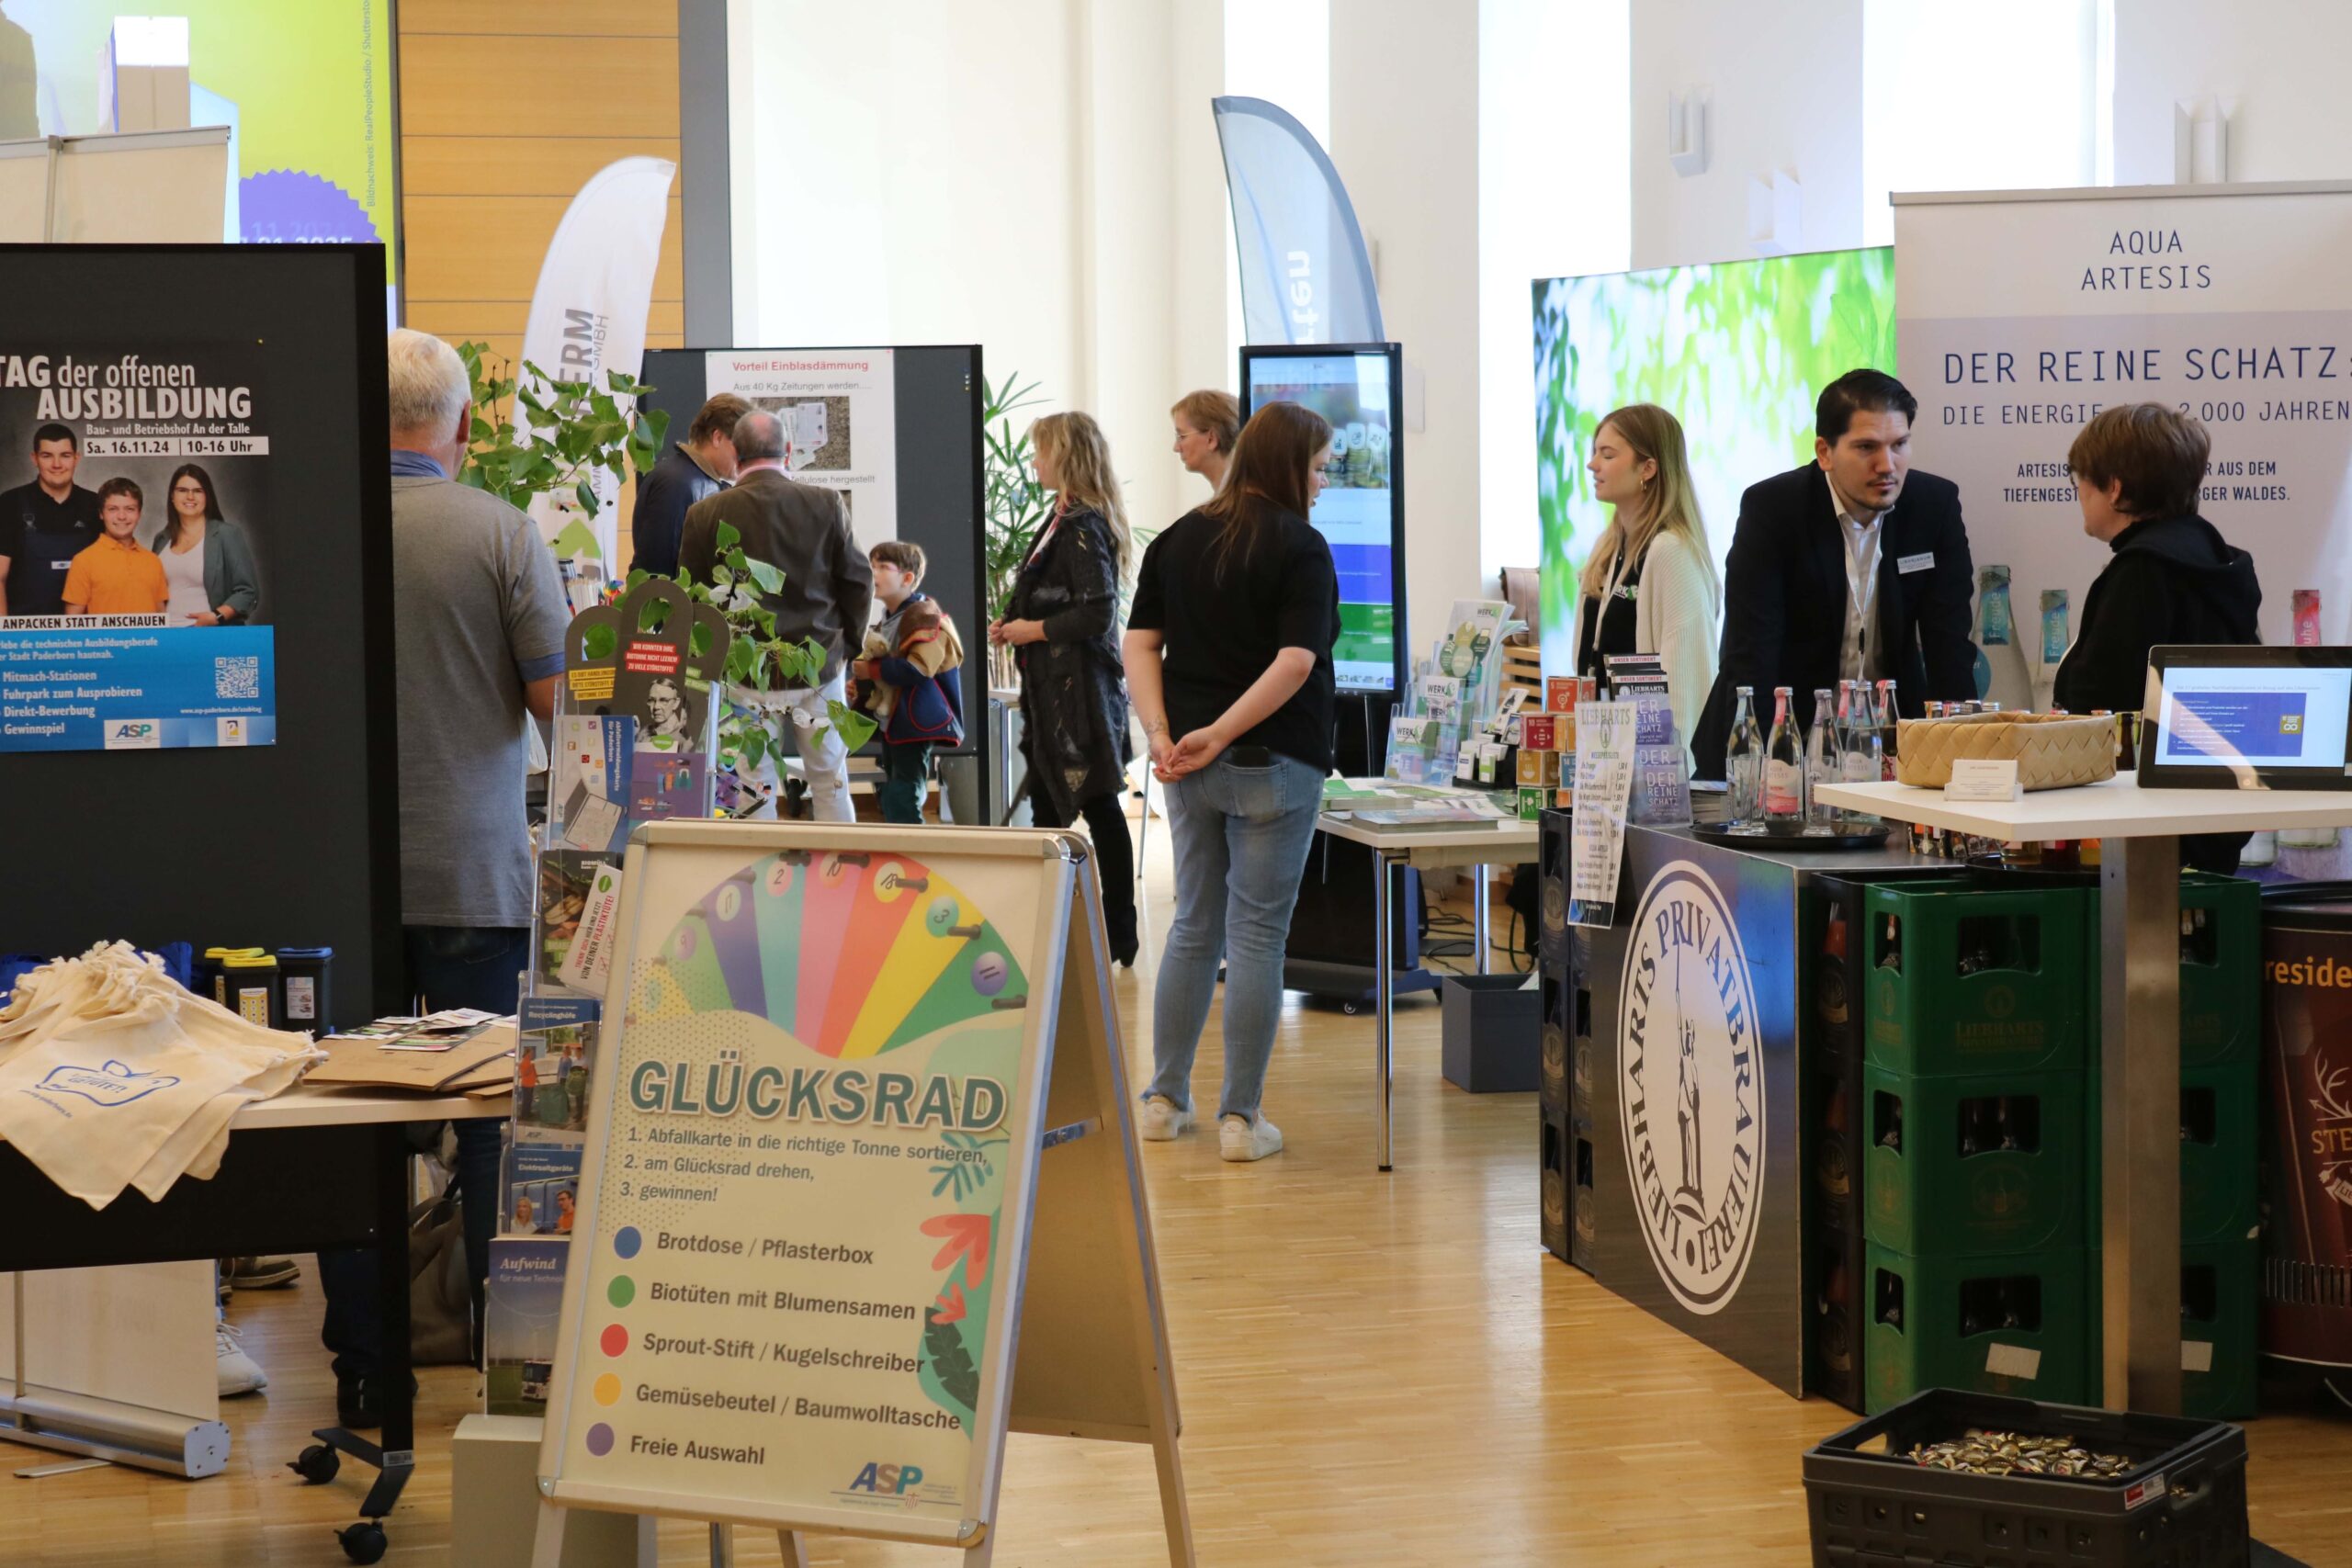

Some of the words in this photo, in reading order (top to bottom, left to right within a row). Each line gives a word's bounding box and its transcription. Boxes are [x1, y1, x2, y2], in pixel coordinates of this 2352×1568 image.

[2109, 230, 2183, 255] AQUA
[2081, 265, 2211, 291] ARTESIS
[58, 355, 98, 387] der
[106, 355, 196, 387] offenen
[732, 362, 768, 371] Vorteil
[772, 361, 868, 373] Einblasdämmung
[1945, 352, 2017, 384] DER
[2039, 350, 2162, 382] REINE
[733, 383, 751, 391] Aus
[766, 383, 778, 392] Kg
[781, 382, 825, 392] Zeitungen
[37, 387, 252, 420] AUSBILDUNG
[1943, 405, 1985, 425] DIE
[2002, 403, 2103, 424] ENERGIE
[2259, 400, 2349, 421] JAHREN
[85, 423, 109, 435] Bau-
[113, 423, 131, 434] und
[134, 423, 191, 435] Betriebshof
[193, 423, 207, 434] An
[209, 423, 224, 434] der
[228, 423, 250, 434] Talle
[86, 441, 106, 455] Sa.
[111, 441, 169, 453] 16.11.24
[187, 441, 225, 452] 10-16
[230, 441, 254, 452] Uhr
[2217, 462, 2244, 476] AUS
[2248, 461, 2277, 476] DEM
[830, 475, 875, 485] hergestellt
[2233, 486, 2290, 501] WALDES.
[3, 618, 62, 629] ANPACKEN
[65, 617, 97, 628] STATT
[102, 615, 166, 627] ANSCHAUEN
[1989, 592, 2001, 638] Freude
[2050, 612, 2061, 657] Freude
[8, 653, 30, 661] Stadt
[32, 651, 75, 660] Paderborn
[3, 671, 96, 682] Mitmach-Stationen
[4, 689, 50, 701] Fuhrpark
[52, 690, 74, 699] zum
[76, 687, 142, 700] Ausprobieren
[4, 705, 96, 719] Direkt-Bewerbung
[1639, 699, 1660, 715] ER
[5, 723, 65, 737] Gewinnspiel
[116, 724, 153, 739] ASP
[1646, 772, 1678, 787] DER
[1647, 787, 1678, 796] REINE
[1648, 797, 1678, 807] SCHATZ
[827, 861, 842, 876] 10
[774, 869, 785, 885] 2
[595, 896, 615, 942] PLASTIKTÜTE!
[933, 909, 950, 924] 3
[585, 941, 599, 965] DEINER
[581, 965, 591, 980] VON
[528, 1011, 576, 1021] Recyclinghöfe
[629, 1050, 1007, 1131] GLÜCKSRAD
[1655, 900, 1753, 1275] PRIVATBRAUEREI
[1628, 942, 1684, 1261] LIEBHARTS
[628, 1128, 642, 1143] 1.
[648, 1129, 732, 1148] Abfallkarte
[738, 1133, 752, 1148] in
[758, 1134, 781, 1150] die
[786, 1135, 845, 1156] richtige
[852, 1139, 900, 1157] Tonne
[907, 1144, 988, 1167] sortieren,
[624, 1155, 639, 1169] 2.
[644, 1158, 668, 1171] am
[673, 1156, 751, 1178] Glücksrad
[756, 1161, 815, 1182] drehen,
[619, 1182, 634, 1197] 3.
[639, 1183, 718, 1202] gewinnen!
[657, 1232, 743, 1255] Brotdose
[749, 1238, 758, 1258] /
[761, 1239, 874, 1265] Pflasterbox
[500, 1257, 557, 1272] Aufwind
[650, 1282, 729, 1306] Biotüten
[737, 1288, 767, 1309] mit
[774, 1291, 916, 1320] Blumensamen
[643, 1334, 755, 1363] Sprout-Stift
[759, 1342, 768, 1362] /
[773, 1344, 925, 1374] Kugelschreiber
[636, 1384, 775, 1415] Gemüsebeutel
[781, 1396, 790, 1416] /
[795, 1398, 961, 1430] Baumwolltasche
[630, 1435, 678, 1458] Freie
[684, 1440, 765, 1466] Auswahl
[850, 1461, 923, 1495] ASP
